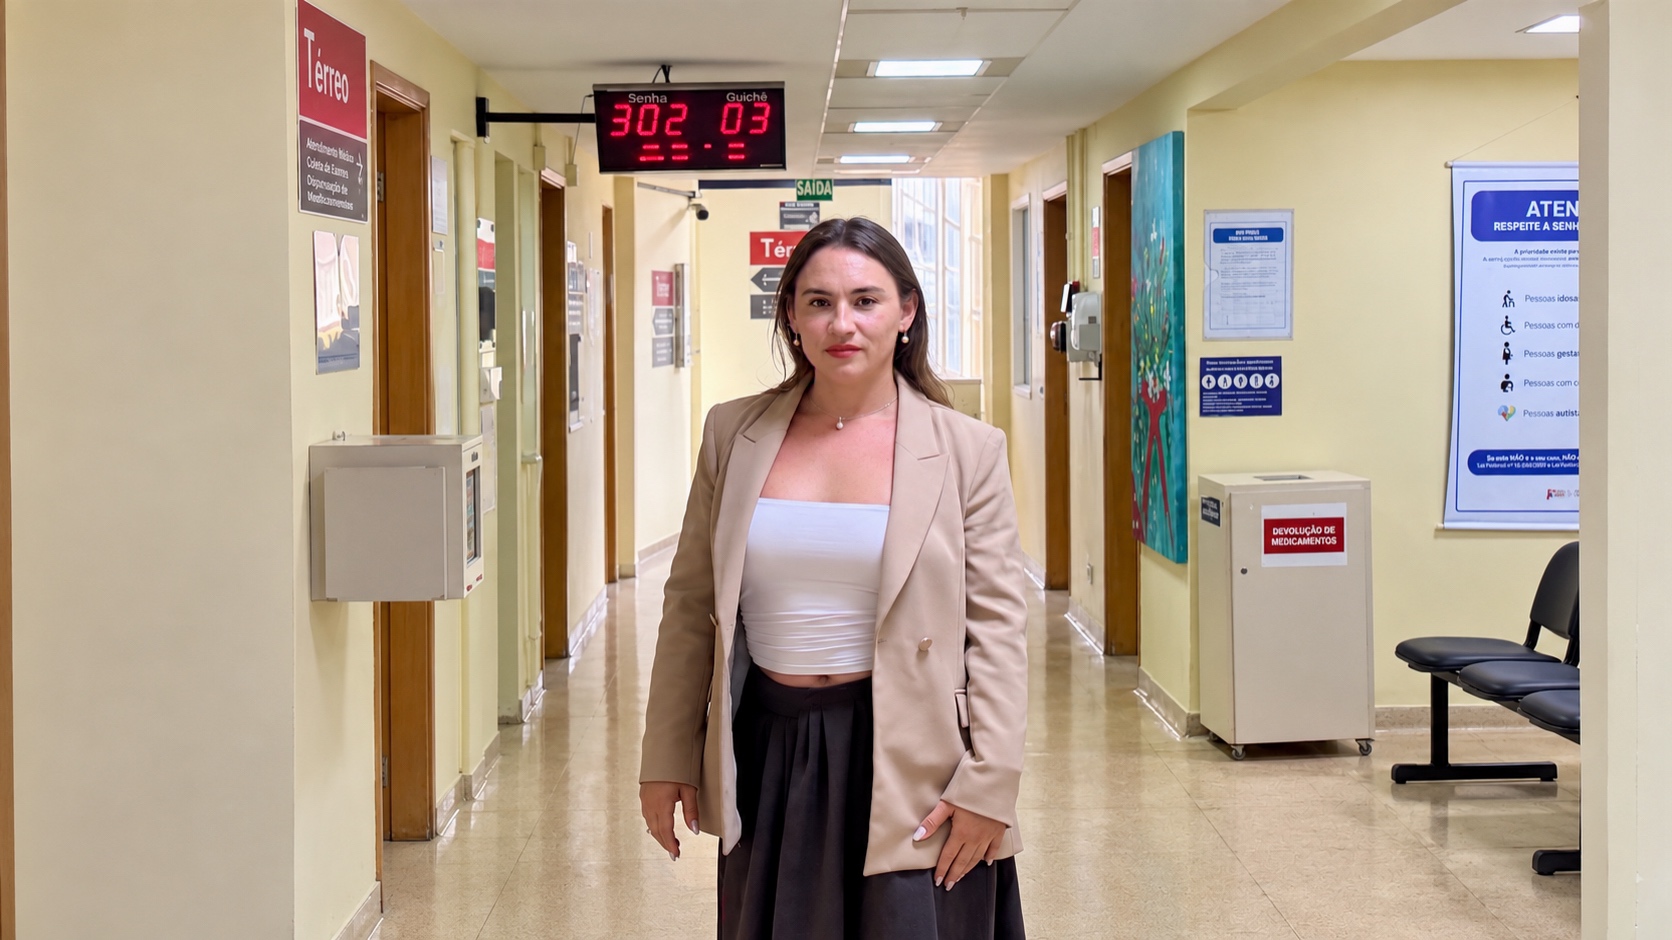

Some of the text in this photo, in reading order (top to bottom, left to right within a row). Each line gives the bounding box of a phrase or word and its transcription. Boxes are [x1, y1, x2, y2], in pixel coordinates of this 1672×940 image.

[304, 27, 349, 104] Térreo
[628, 92, 768, 104] Senha Guichê
[610, 102, 771, 137] 302 03
[796, 180, 832, 196] SAÍDA
[1526, 200, 1579, 217] ATEN
[1493, 221, 1579, 231] RESPEITE A SENH
[1525, 294, 1556, 302] Pessoas
[1524, 321, 1555, 329] Pessoas
[1524, 349, 1579, 359] Pessoas gesta
[1523, 379, 1555, 387] Pessoas
[1523, 409, 1554, 417] Pessoas
[1272, 524, 1336, 536] DEVOLUÇÃO DE
[1271, 536, 1337, 546] MEDICAMENTOS
